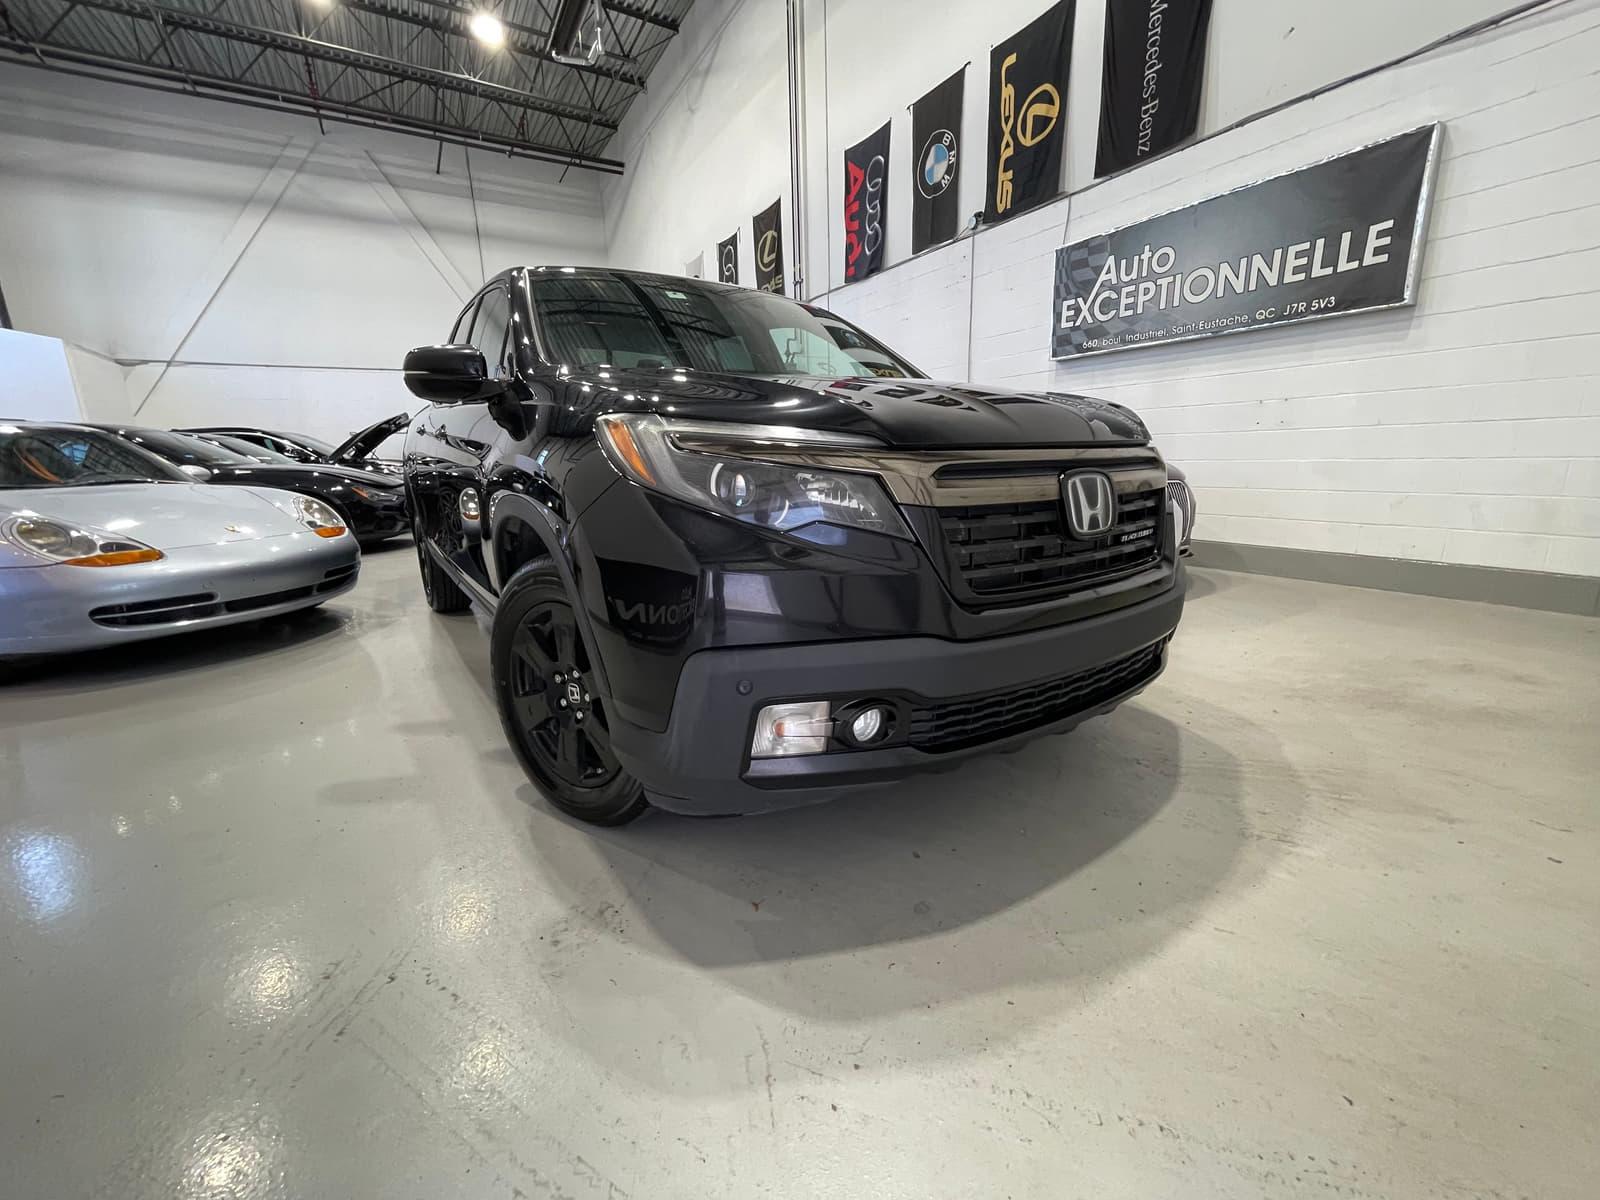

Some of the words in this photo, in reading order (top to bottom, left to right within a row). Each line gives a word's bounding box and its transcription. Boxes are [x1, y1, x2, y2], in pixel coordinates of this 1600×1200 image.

[1136, 0, 1168, 157] Mercedes-Benz
[941, 133, 956, 188] BMW
[996, 52, 1017, 214] LEXUS
[1060, 219, 1395, 329] EXCEPTIONNELLE
[1098, 245, 1177, 286] Auto
[1255, 308, 1275, 320] QC
[1283, 302, 1306, 315] J7R
[1310, 296, 1336, 311] 5V3
